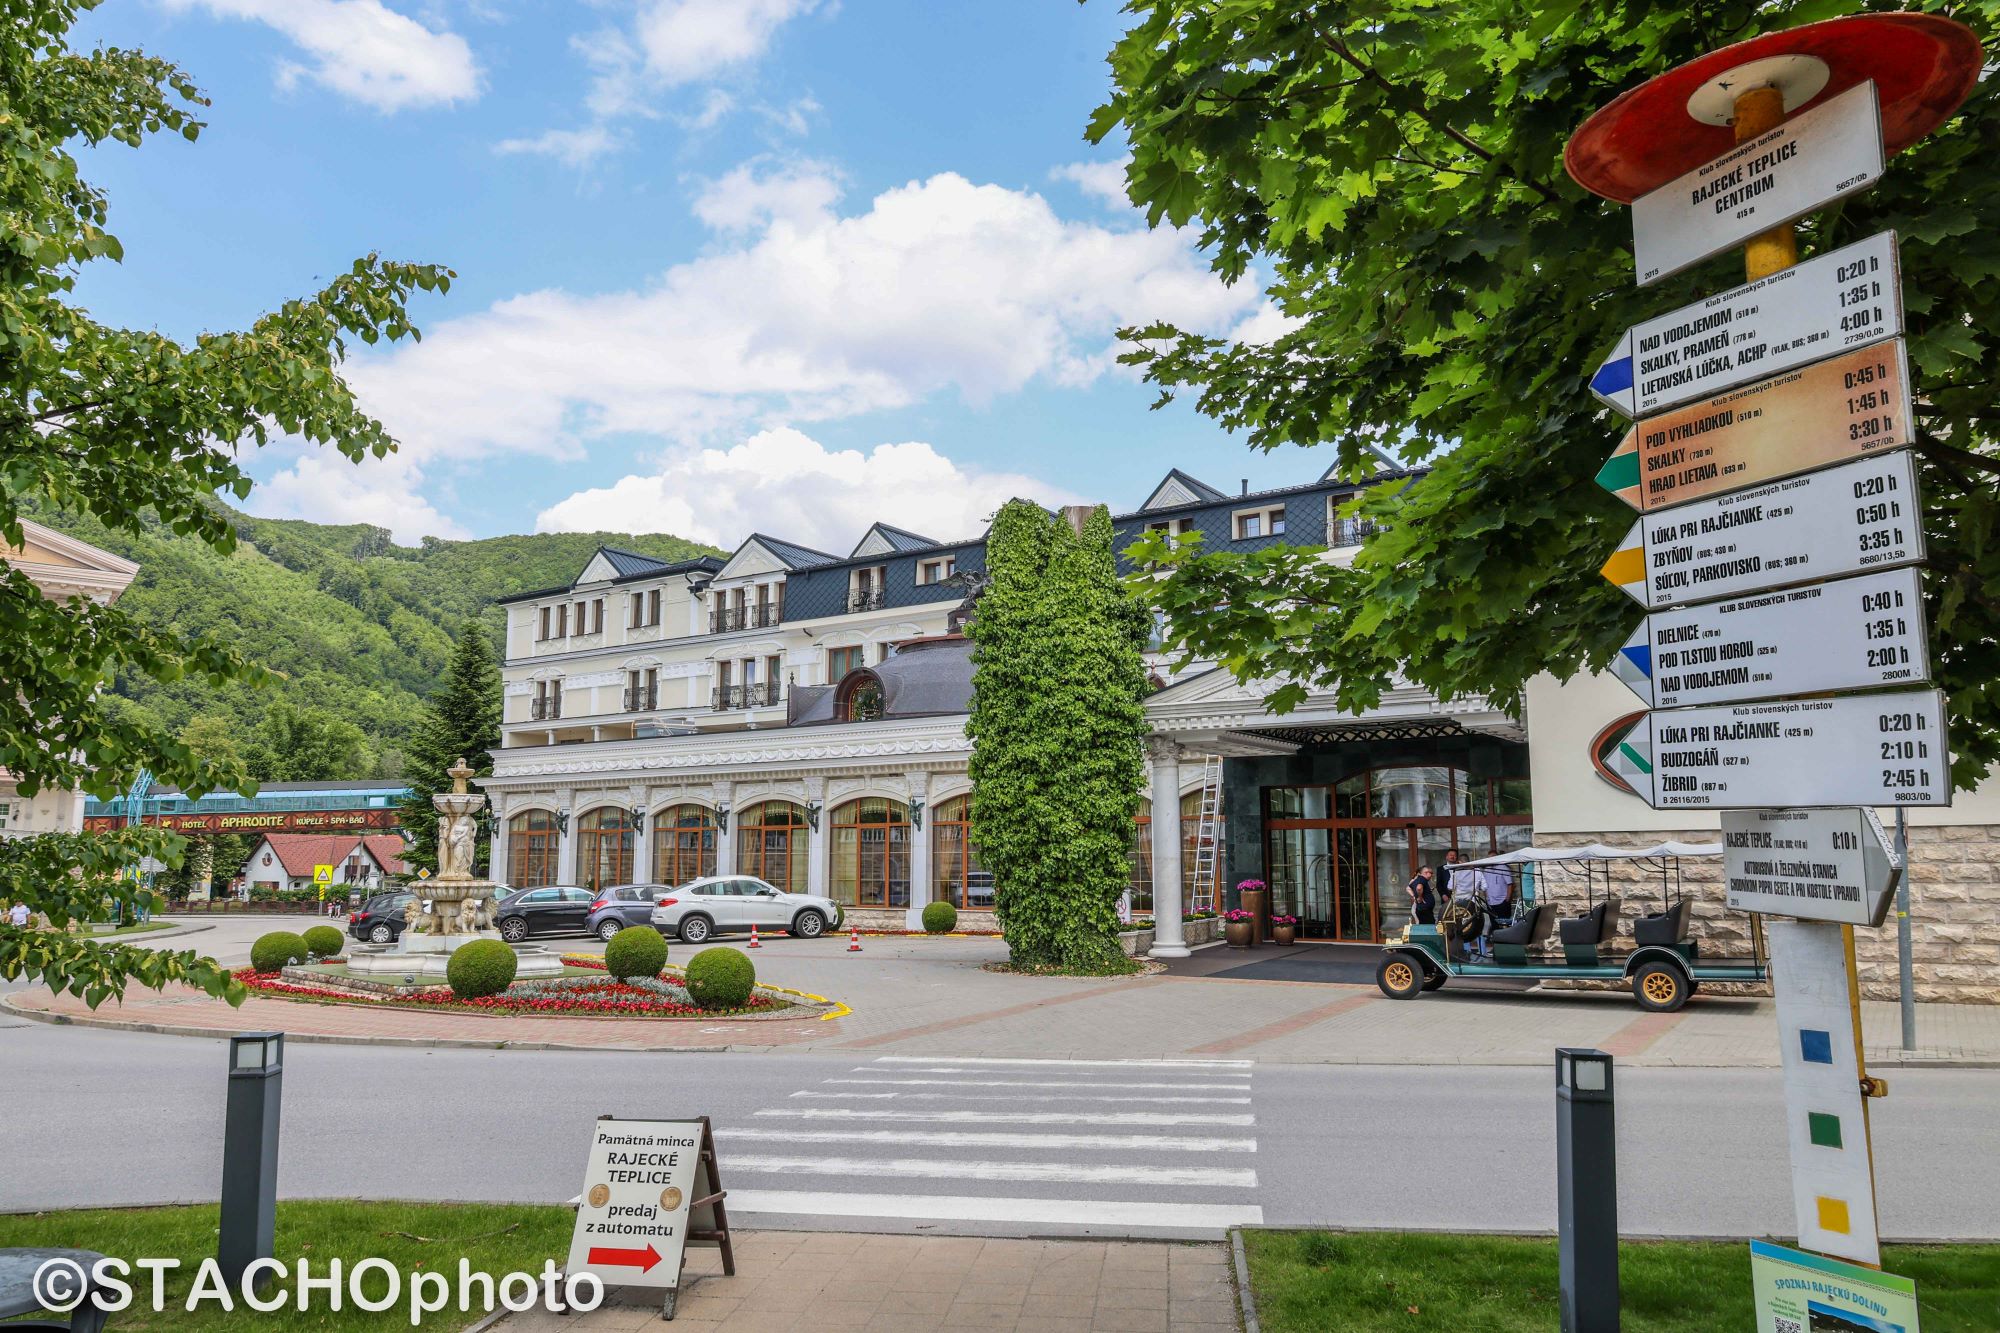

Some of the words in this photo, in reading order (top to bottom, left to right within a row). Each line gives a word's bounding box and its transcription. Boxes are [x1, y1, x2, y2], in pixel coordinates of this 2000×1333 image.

[1699, 165, 1714, 177] Klub
[1715, 143, 1757, 169] slovenských
[1758, 129, 1785, 146] turistov
[1692, 165, 1743, 205] RAJECKÉ
[1747, 140, 1797, 177] TEPLICE
[1836, 173, 1867, 191] 5657/0b
[1715, 173, 1774, 214] CENTRUM
[1736, 209, 1748, 220] 415
[1749, 207, 1755, 215] m
[1644, 268, 1659, 280] 2015
[1837, 259, 1866, 284] 0:20
[1870, 255, 1879, 272] h
[1705, 295, 1721, 309] Klub
[1722, 279, 1766, 301] slovenských
[1768, 270, 1796, 285] turistov
[1839, 283, 1868, 308] 1:35
[1872, 281, 1880, 297] h
[1840, 309, 1870, 332] 4:00
[1874, 306, 1882, 322] h
[1640, 334, 1660, 354] NAD
[1663, 308, 1732, 345] VODOJEMOM
[1641, 350, 1680, 375] SKALKY,
[1684, 329, 1729, 361] PRAMEŇ
[1642, 365, 1693, 397] LIETAVSKÁ
[1696, 355, 1734, 379] LÚČKA,
[1738, 343, 1767, 366] ACHP
[1844, 366, 1874, 389] 0:45
[1878, 363, 1886, 379] h
[1712, 397, 1727, 408] Klub
[1729, 382, 1772, 402] slovenských
[1774, 372, 1802, 387] turistov
[1642, 397, 1658, 408] 2015
[1847, 392, 1876, 414] 1:45
[1881, 389, 1889, 406] h
[1646, 431, 1665, 450] POD
[1669, 410, 1733, 442] VYHLIADKOU
[1849, 418, 1880, 440] 3:30
[1884, 415, 1892, 432] h
[1861, 436, 1894, 450] 5657/0b
[1648, 448, 1686, 472] SKALKY
[1649, 474, 1675, 494] HRAD
[1679, 462, 1718, 486] LIETAVA
[1854, 476, 1884, 499] 0:20
[1888, 474, 1897, 491] h
[1650, 496, 1666, 506] 2015
[1718, 496, 1734, 507] Klub
[1736, 485, 1780, 502] slovenských
[1781, 478, 1810, 491] turistov
[1856, 502, 1887, 526] 0:50
[1891, 501, 1900, 518] h
[1652, 526, 1677, 545] LÚKA
[1680, 521, 1698, 539] PRI
[1702, 505, 1762, 534] RAJČIANKE
[1767, 508, 1782, 520] (425
[1784, 506, 1794, 516] m)
[1859, 529, 1890, 552] 3:35
[1894, 527, 1903, 545] h
[1653, 546, 1693, 568] ZBYŇOV
[1693, 556, 1761, 584] PARKOVISKO
[1656, 594, 1672, 603] 2015
[1719, 605, 1736, 614] KLUB
[1738, 595, 1785, 611] SLOVENSKÝCH
[1787, 588, 1822, 601] TURISTOV
[1862, 591, 1891, 613] 0:40
[1895, 590, 1904, 607] h
[1657, 624, 1699, 646] DIELNICE
[1865, 619, 1894, 640] 1:35
[1898, 618, 1906, 635] h
[1659, 653, 1677, 669] POD
[1680, 646, 1717, 666] TLSTOU
[1720, 640, 1754, 661] HOROU
[1867, 647, 1897, 668] 2:00
[1900, 646, 1909, 664] h
[1660, 677, 1680, 694] NAD
[1683, 666, 1749, 690] VODOJEMOM
[1882, 669, 1911, 680] 2800M
[1662, 697, 1678, 705] 2016
[1732, 707, 1750, 716] Klub
[1752, 703, 1799, 715] slovenských
[1801, 702, 1833, 711] turistov
[1660, 725, 1687, 744] LÚKA
[1691, 726, 1710, 742] PRI
[1714, 721, 1780, 741] RAJČIANKE
[1784, 728, 1801, 738] (425
[1804, 727, 1814, 737] m)
[1879, 713, 1912, 732] 0:20
[1916, 713, 1926, 730] h
[1661, 747, 1719, 768] BUDZOGÁŇ
[1740, 756, 1750, 766] m)
[1881, 742, 1913, 760] 2:10
[1918, 741, 1927, 758] h
[1662, 774, 1698, 792] ŽIBRID
[1718, 782, 1727, 791] m)
[1883, 769, 1915, 788] 2:45
[1920, 769, 1929, 787] h
[1670, 796, 1710, 804] 26116/2015
[1895, 792, 1931, 801] 9803/0b
[182, 820, 207, 829] HOTEL
[221, 816, 284, 828] APHRODITE
[1726, 829, 1750, 848] RAJECKÉ
[1750, 832, 1772, 848] TEPLICE
[1832, 832, 1849, 850] 0:10
[1852, 832, 1857, 850] h
[1775, 862, 1779, 876] A
[1812, 864, 1838, 879] STANICA
[1774, 881, 1790, 896] CESTE
[1791, 882, 1795, 896] A
[1796, 882, 1805, 897] PRI
[1807, 883, 1832, 900] KOSTOLE
[1833, 885, 1860, 902] VPRAVO!
[598, 1134, 653, 1146] Pamätná
[656, 1136, 695, 1147] minca
[607, 1152, 678, 1167] RAJECKÉ
[608, 1170, 672, 1184] TEPLICE
[608, 1204, 658, 1220] predaj
[586, 1223, 594, 1233] z
[598, 1222, 674, 1237] automatu
[1775, 1278, 1811, 1290] SPOZNAJ
[1812, 1282, 1850, 1300] RAJECKÚ
[1852, 1293, 1887, 1317] DOLINU
